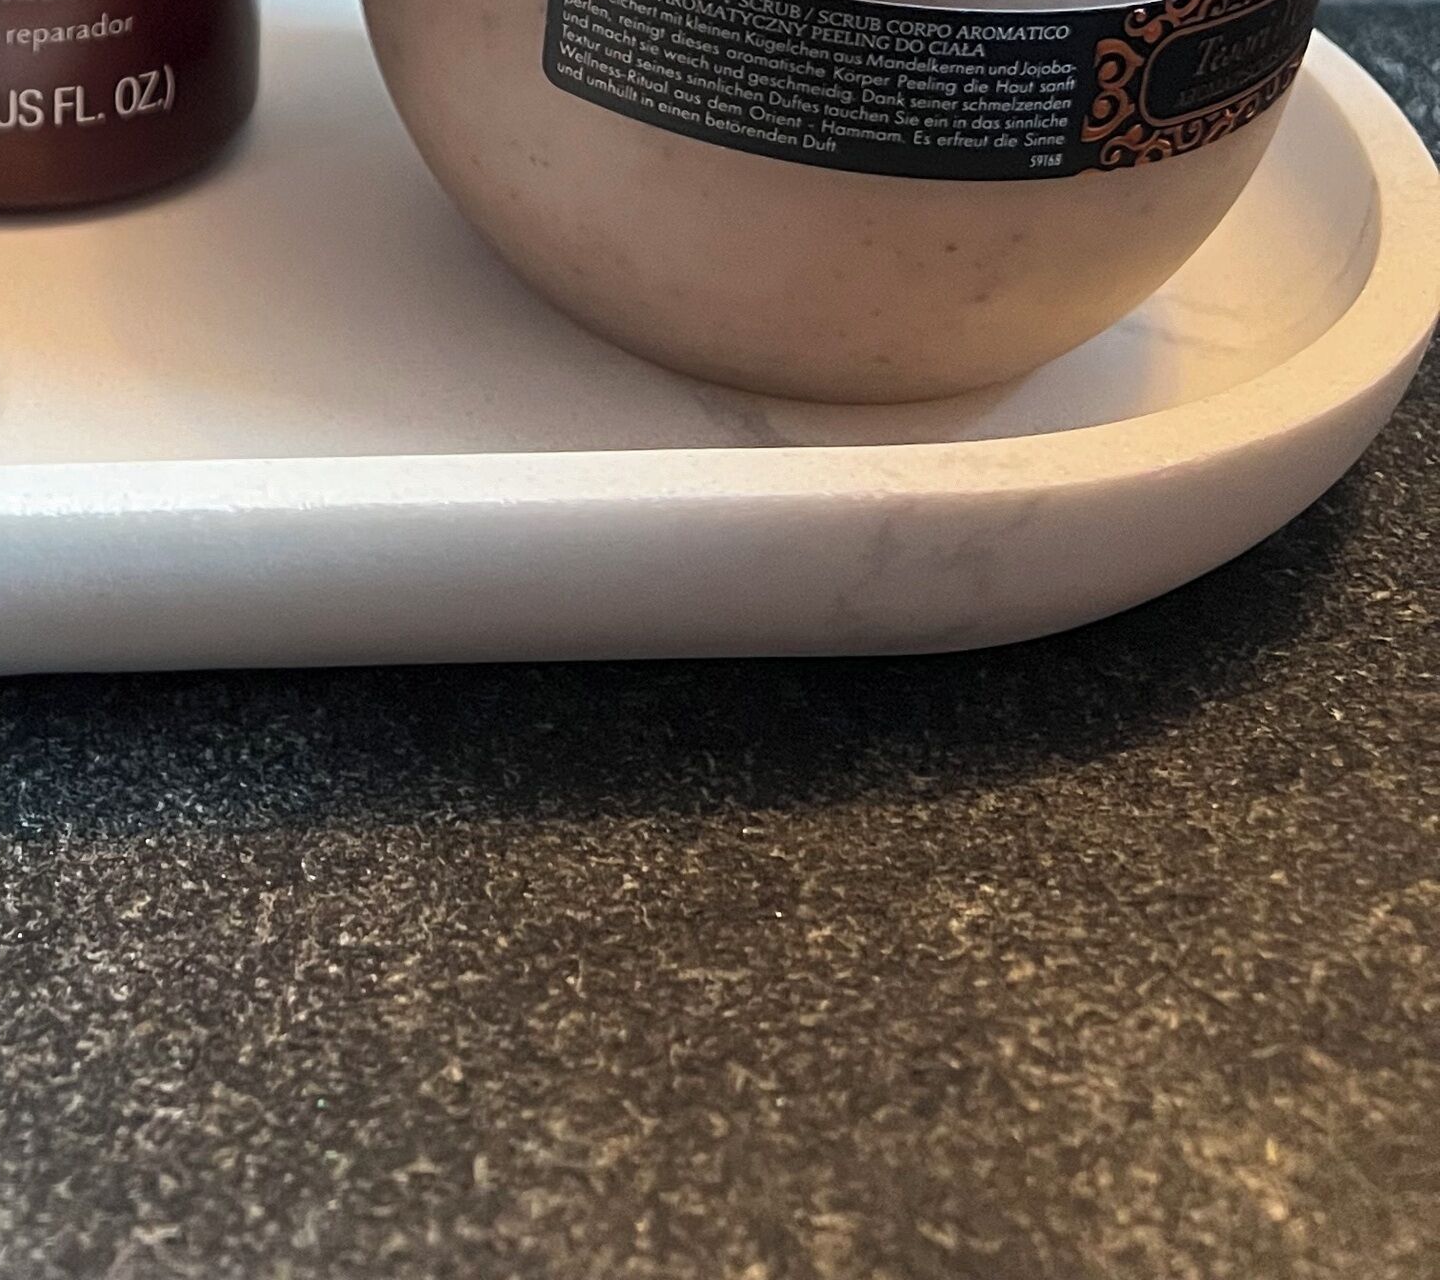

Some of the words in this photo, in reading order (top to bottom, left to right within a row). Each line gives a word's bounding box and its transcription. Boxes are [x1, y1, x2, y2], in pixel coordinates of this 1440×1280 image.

[6, 12, 133, 52] reparador
[563, 10, 588, 29] und
[591, 22, 637, 47] macht
[639, 39, 659, 55] sie
[664, 47, 710, 70] weich
[713, 63, 745, 80] und
[862, 89, 905, 107] Dank
[910, 95, 958, 110] seiner
[962, 96, 1072, 112] schmelzenden
[619, 14, 665, 41] reinigt
[671, 30, 719, 55] dieses
[726, 48, 826, 78] aromatische
[832, 66, 890, 88] Körper
[897, 74, 958, 96] Peeling
[963, 78, 989, 93] die
[996, 80, 1034, 93] Haut
[1040, 76, 1077, 92] sanft
[660, 8, 683, 27] mit
[685, 14, 740, 42] kleinen
[744, 30, 830, 60] Kügelchen
[833, 51, 862, 66] aus
[866, 53, 985, 75] Mandelkernen
[988, 60, 1017, 76] und
[1020, 60, 1077, 78] Jojoba-
[811, 25, 890, 51] PEELING
[894, 37, 924, 54] DO
[928, 41, 985, 57] CIAŁA
[818, 10, 881, 32] SCRUB
[886, 19, 952, 39] CORPO
[955, 25, 1071, 41] AROMATICO
[54, 85, 105, 125] FL.
[115, 64, 175, 116] OZ.)
[557, 62, 583, 81] und
[586, 75, 638, 102] umhüllt
[641, 93, 654, 108] in
[658, 101, 701, 123] einen
[705, 110, 798, 145] betörenden
[802, 134, 837, 152] Duft
[560, 41, 669, 94] Wellness-Ritual
[673, 88, 701, 105] aus
[707, 96, 743, 116] dem
[749, 105, 802, 128] Orient
[913, 129, 930, 145] Es
[937, 133, 990, 148] erfreut
[994, 135, 1018, 148] die
[1024, 132, 1065, 148] Sinne
[561, 23, 601, 52] Textur
[604, 46, 632, 64] und
[637, 57, 682, 81] seines
[686, 72, 764, 102] sinnlichen
[769, 90, 819, 113] Duftes
[824, 104, 889, 124] tauchen
[894, 110, 920, 127] Sie
[924, 114, 948, 128] ein
[952, 115, 967, 129] in
[971, 116, 1000, 130] das
[1005, 113, 1069, 129] sinnliche
